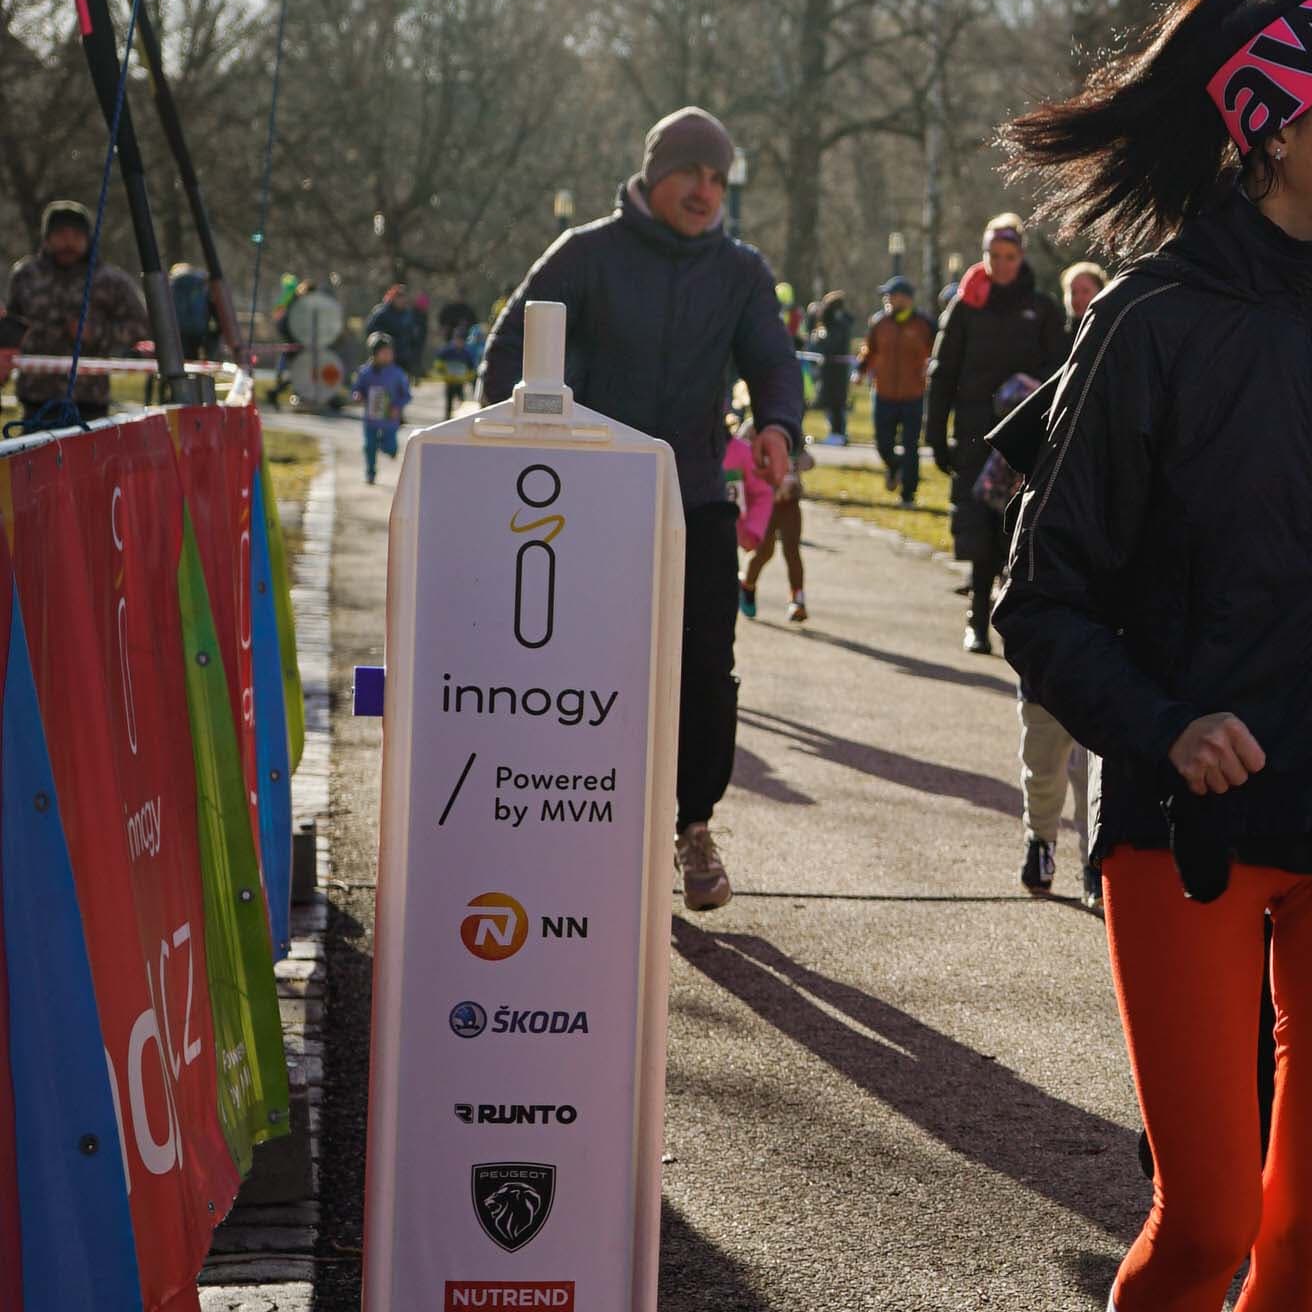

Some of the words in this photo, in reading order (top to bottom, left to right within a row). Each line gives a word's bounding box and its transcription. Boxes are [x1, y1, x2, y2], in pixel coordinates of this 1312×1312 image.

[442, 673, 618, 726] innogy
[496, 766, 617, 791] Powered
[494, 797, 528, 827] by
[541, 800, 613, 823] MVM
[541, 916, 588, 938] NN
[491, 1006, 589, 1034] ŠKODA
[477, 1104, 577, 1124] RUNTO
[479, 1170, 549, 1180] PEUGEOT
[451, 1288, 569, 1308] NUTREND
